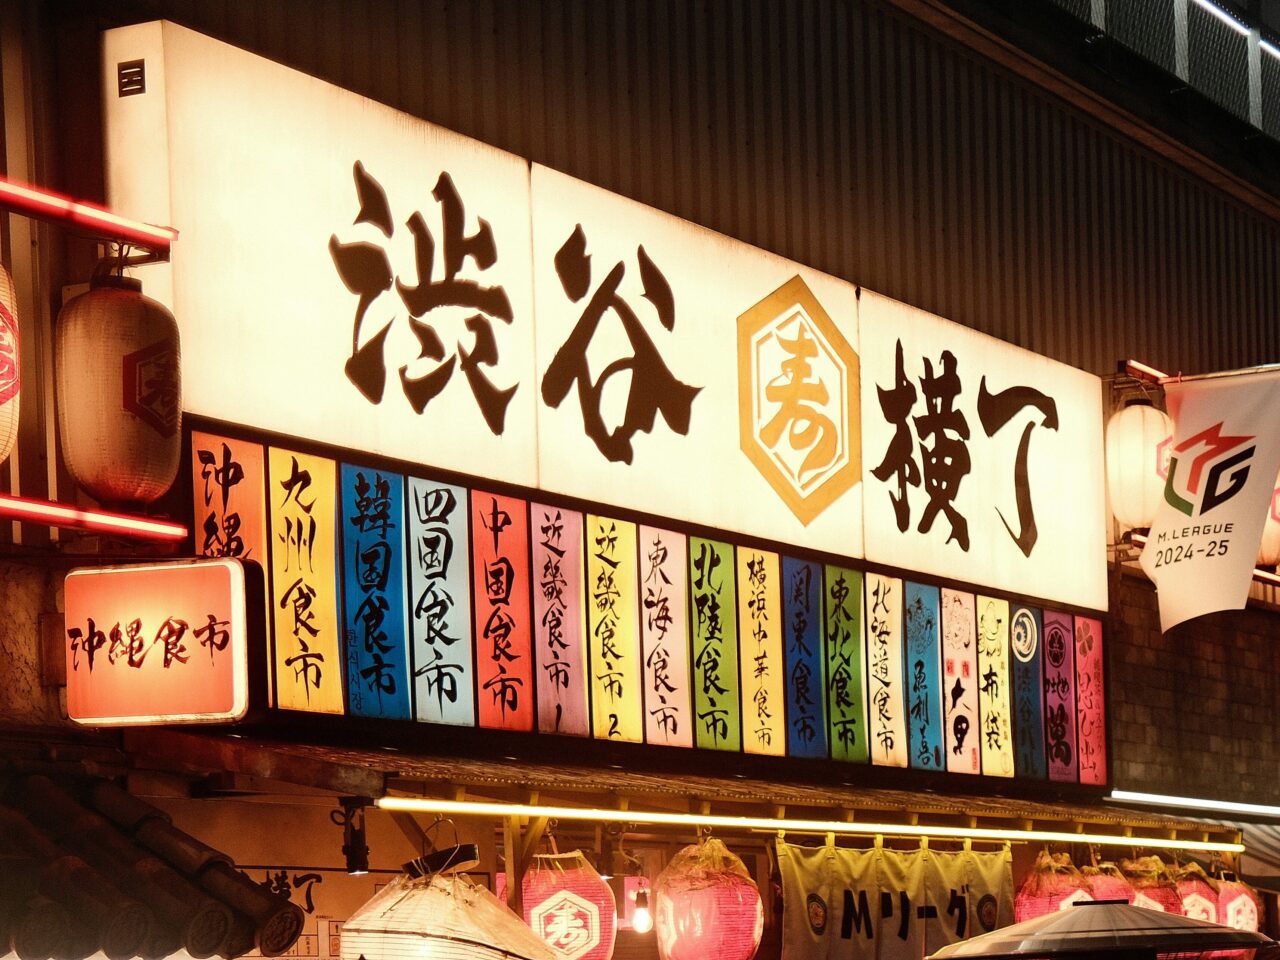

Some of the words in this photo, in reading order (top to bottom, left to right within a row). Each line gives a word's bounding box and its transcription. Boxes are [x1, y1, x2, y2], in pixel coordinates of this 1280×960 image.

[328, 160, 705, 465] 渋谷
[872, 339, 1059, 557] 横丁
[279, 455, 326, 706] 九州食市
[350, 471, 397, 715] 韓国食市
[412, 483, 465, 719] 四国食市
[478, 496, 524, 724] 中国食市
[1154, 540, 1230, 569] 2024-25
[1157, 523, 1235, 544] M.LEAGUE
[67, 614, 231, 676] 沖縄食市
[643, 532, 679, 744] 東海食市
[692, 542, 730, 748] 北陸食市
[746, 552, 773, 750] 横浜中華食市
[789, 563, 816, 750] 関東食市
[827, 570, 856, 754] 東北食市
[870, 578, 896, 759] 北海道食市
[979, 662, 1002, 751] 布袋
[840, 883, 970, 941] Mリーグ
